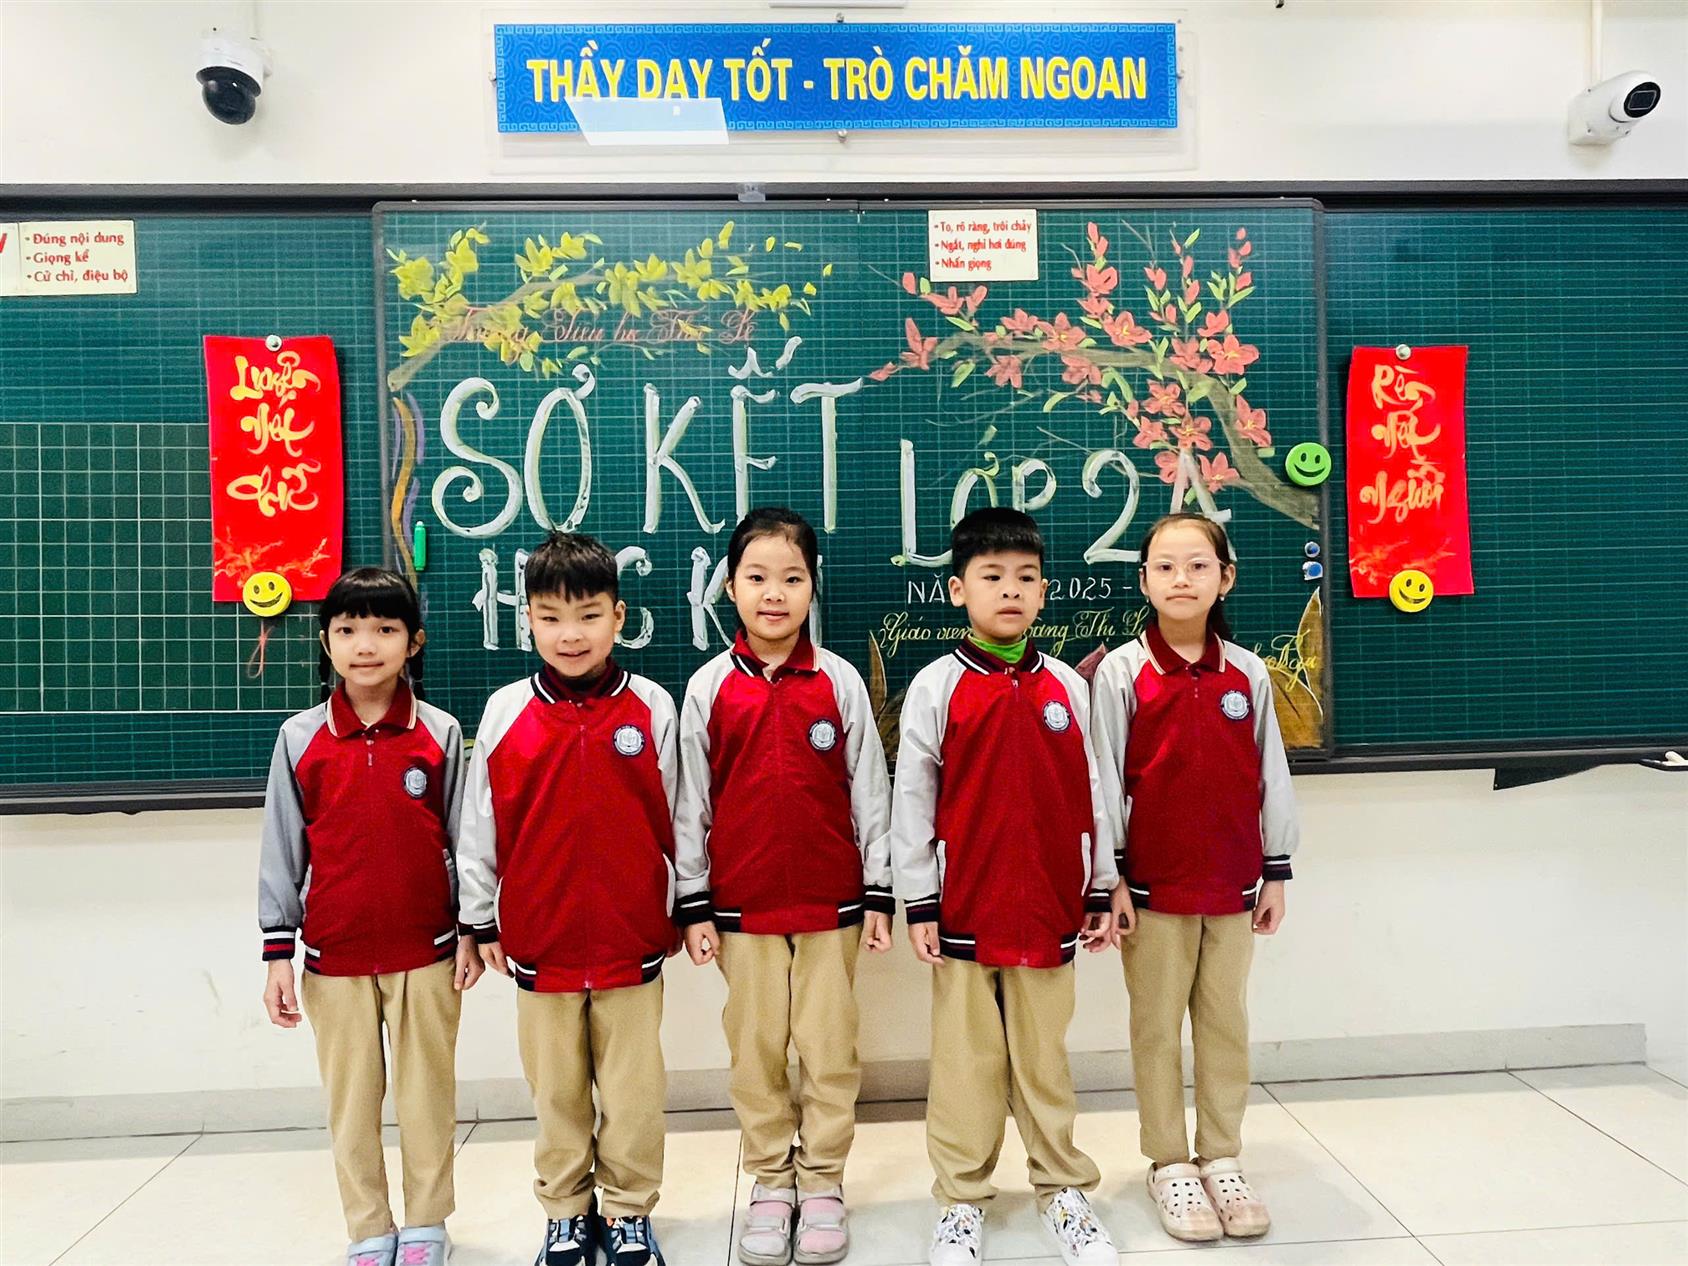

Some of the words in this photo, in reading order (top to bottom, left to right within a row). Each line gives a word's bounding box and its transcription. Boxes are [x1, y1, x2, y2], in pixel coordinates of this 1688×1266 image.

[526, 40, 625, 103] THẦY
[723, 38, 793, 101] TỐT
[823, 46, 894, 101] TRÒ
[904, 45, 1009, 101] CHĂM
[1020, 56, 1147, 100] NGOAN
[33, 233, 66, 247] Đúng
[70, 232, 89, 245] nội
[94, 232, 124, 246] dung
[33, 251, 71, 266] Giọng
[34, 270, 51, 282] Cử
[83, 270, 109, 283] điệu
[113, 269, 128, 282] bộ
[642, 336, 864, 534] KẾT
[1048, 576, 1112, 601] 2025
